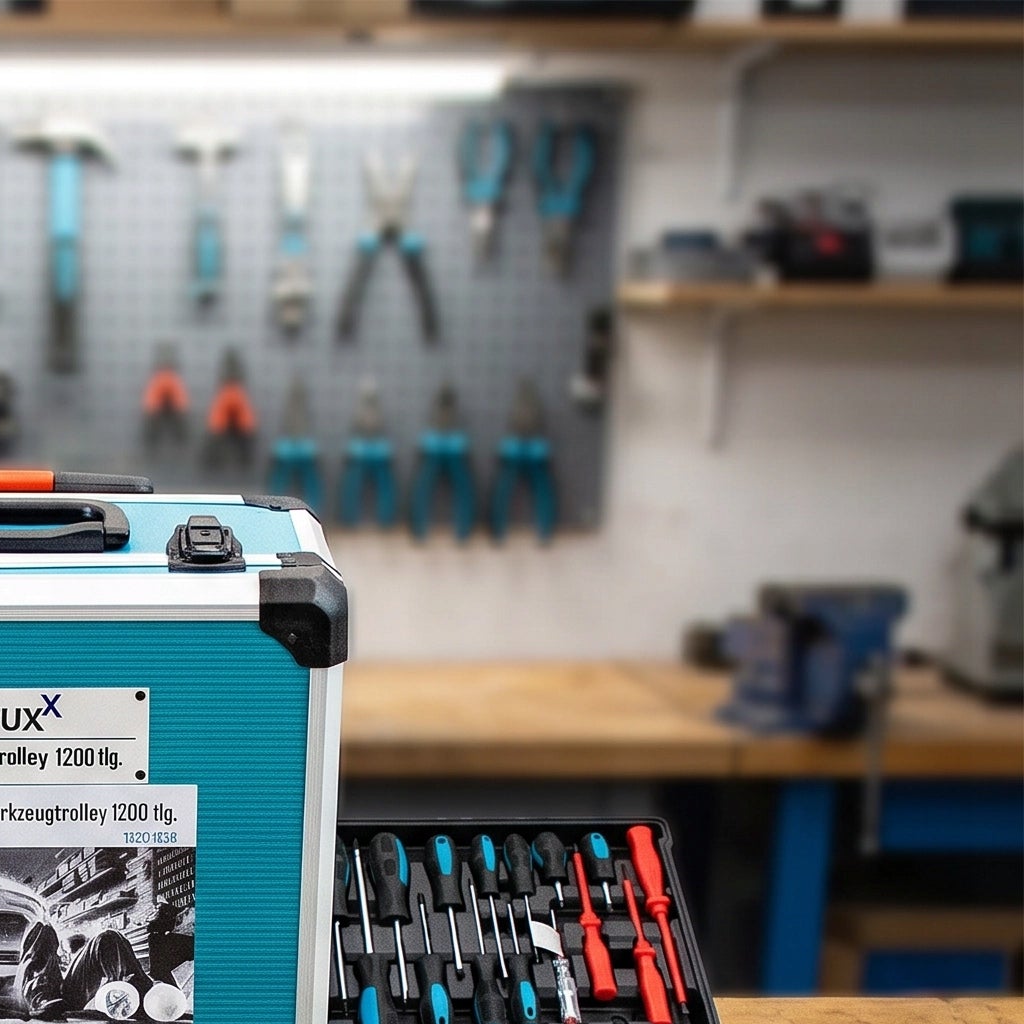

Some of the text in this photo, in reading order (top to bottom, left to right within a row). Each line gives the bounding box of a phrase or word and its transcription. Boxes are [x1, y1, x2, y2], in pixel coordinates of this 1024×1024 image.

[55, 747, 94, 767] 1200
[97, 747, 123, 771] tlg.
[111, 802, 148, 822] 1200
[152, 802, 178, 826] tlg.
